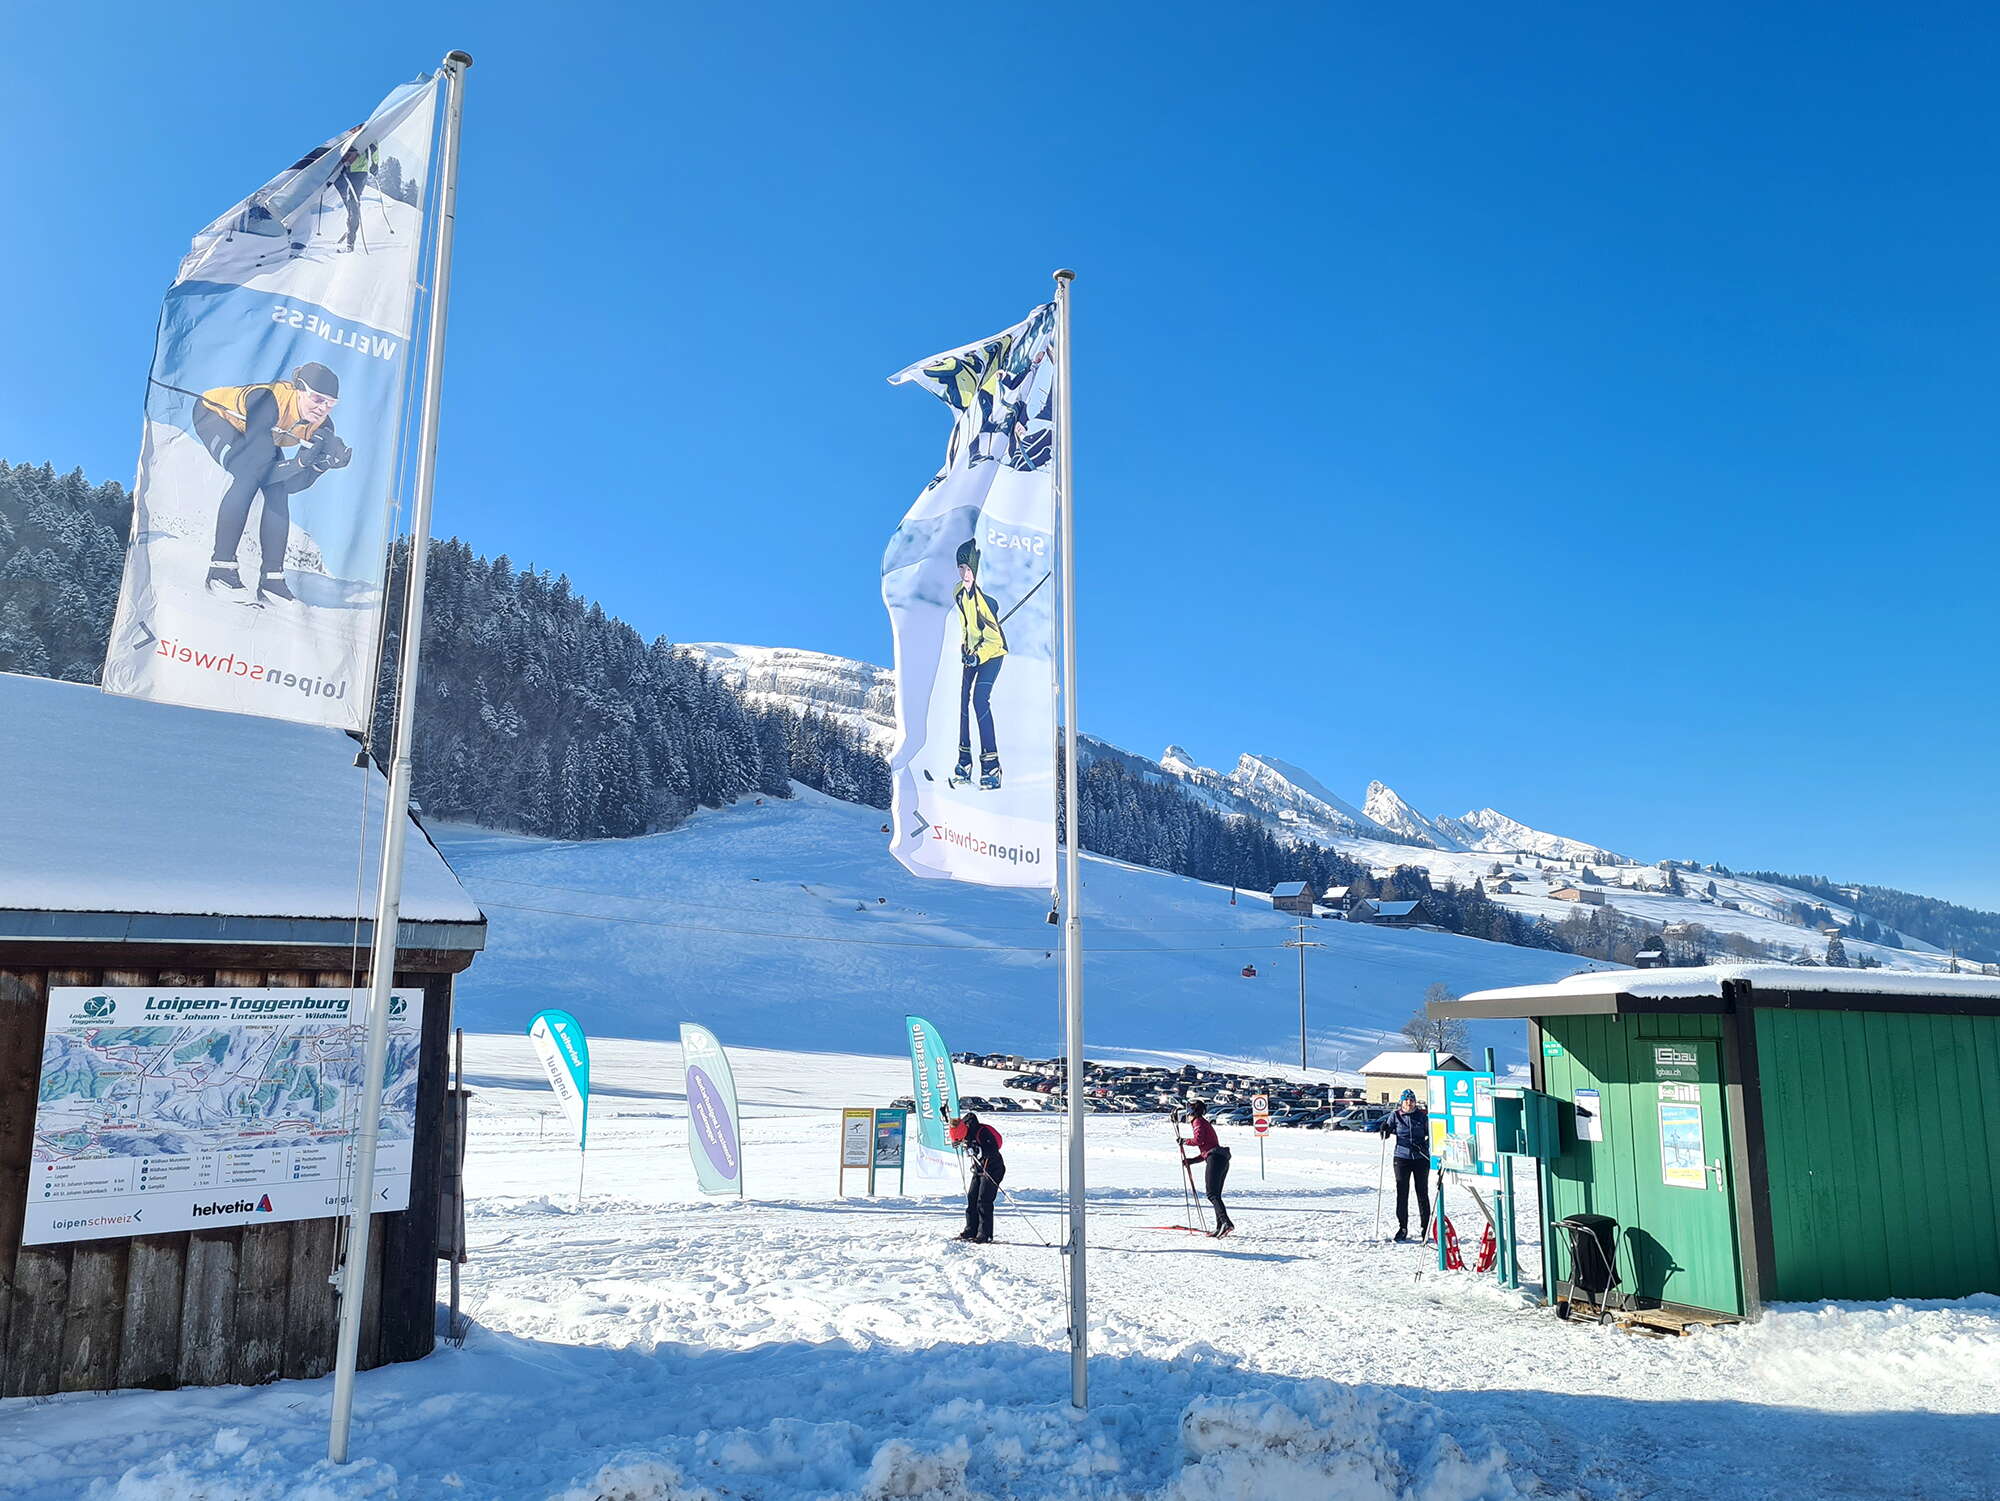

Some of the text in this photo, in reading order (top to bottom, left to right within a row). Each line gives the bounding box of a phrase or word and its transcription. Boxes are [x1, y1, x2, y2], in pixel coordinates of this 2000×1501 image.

[145, 996, 351, 1013] Loipen-Toggenburg
[193, 1199, 254, 1217] helvetia
[52, 1214, 132, 1230] loipenschweiz
